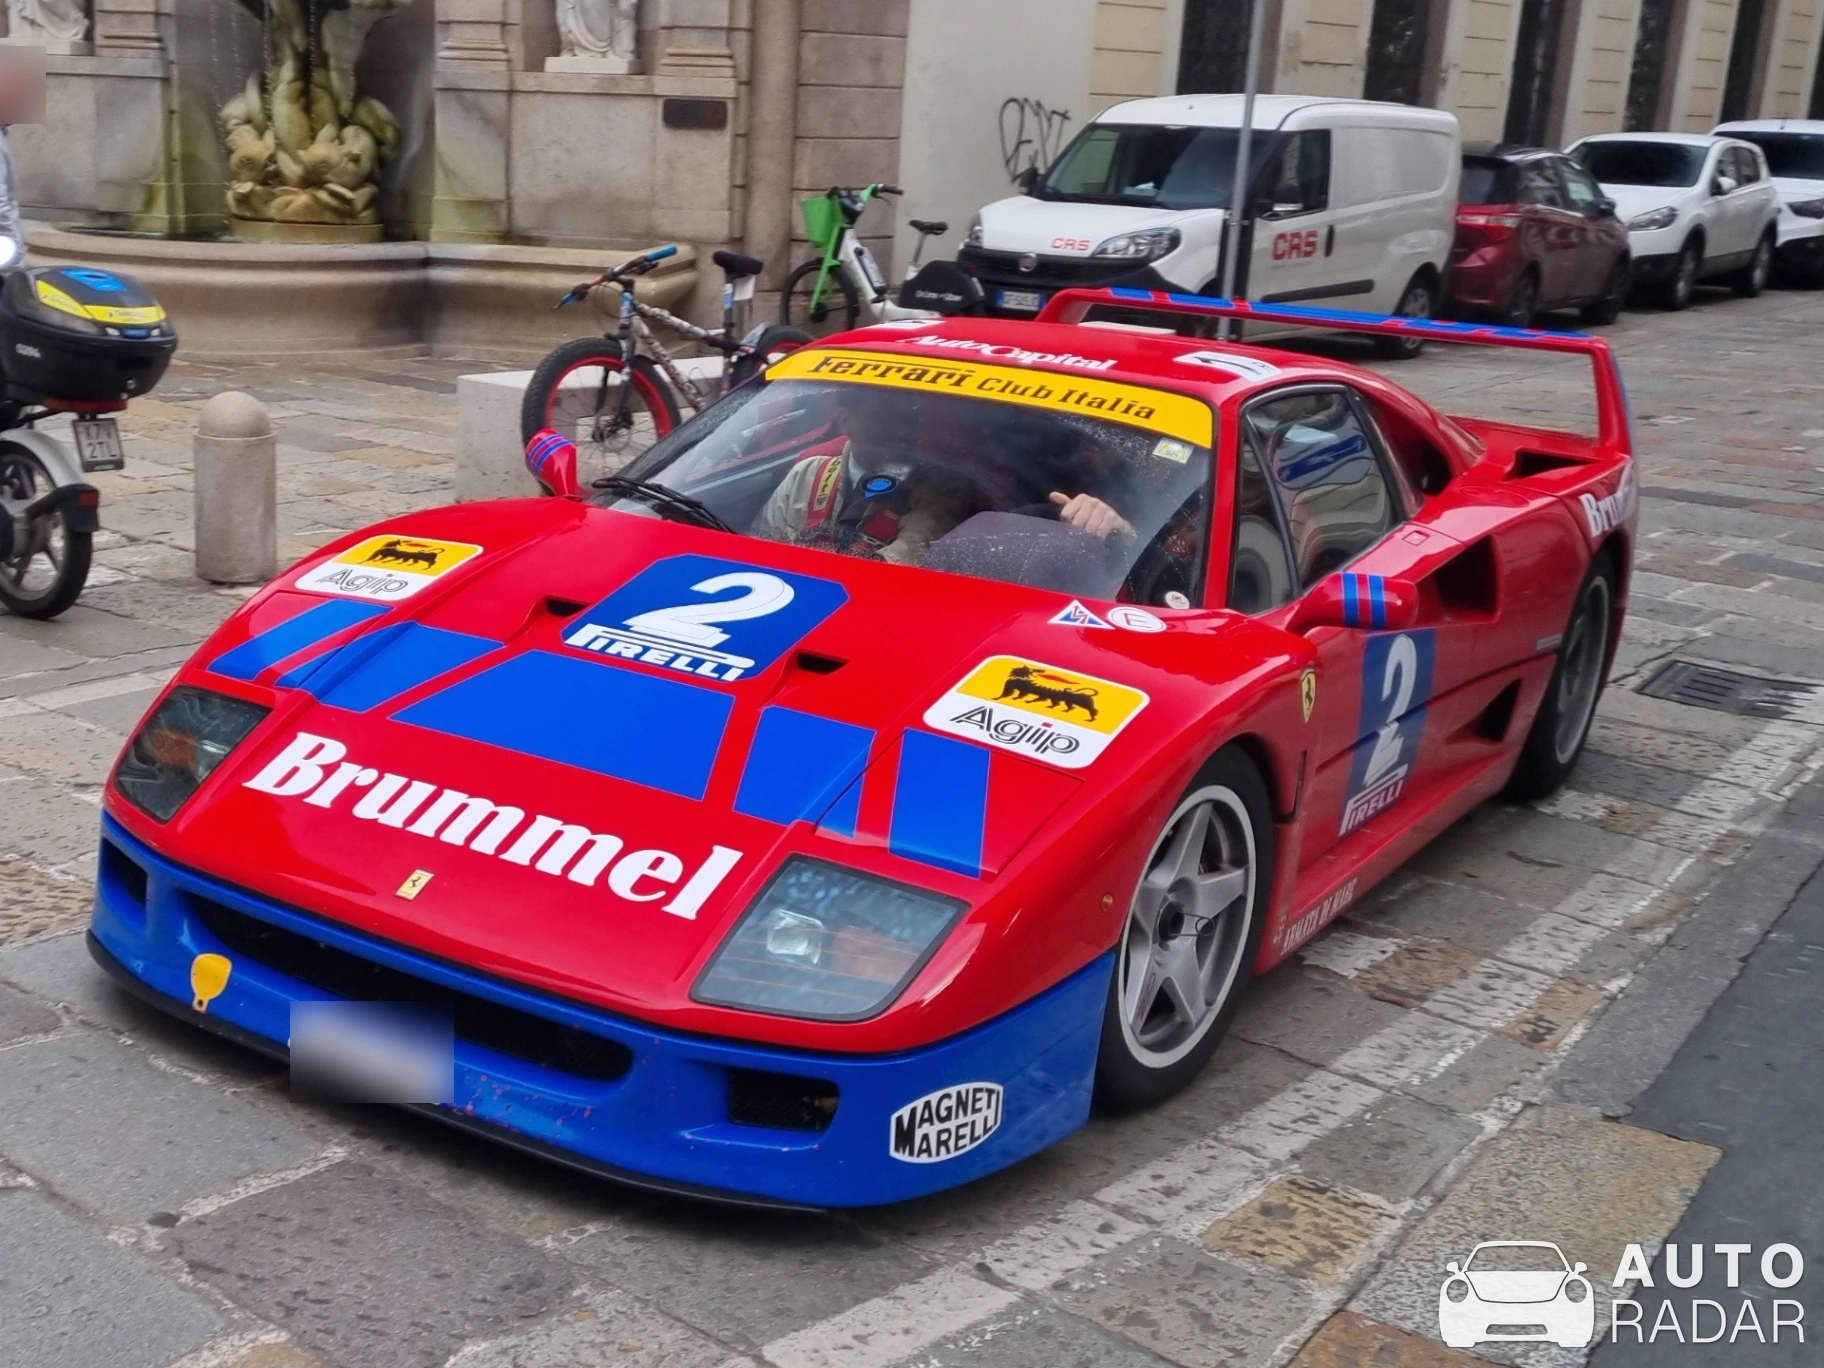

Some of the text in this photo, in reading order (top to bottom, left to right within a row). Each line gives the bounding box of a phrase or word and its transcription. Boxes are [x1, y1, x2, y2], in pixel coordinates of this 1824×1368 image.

[1051, 238, 1091, 251] CRS
[1272, 230, 1318, 260] CRS
[897, 333, 1119, 371] AutoCapital
[806, 356, 1156, 421] Ferrari Club Italia
[305, 568, 409, 595] Agip
[621, 571, 795, 648] 2
[564, 623, 756, 682] PIRELLI
[949, 706, 1081, 755] Agip
[1363, 634, 1418, 787] 2
[1339, 763, 1409, 837] PIRELLI
[243, 732, 743, 920] Brummel
[894, 1087, 1001, 1136] MAGNETI
[894, 1110, 1001, 1158] MARELLI
